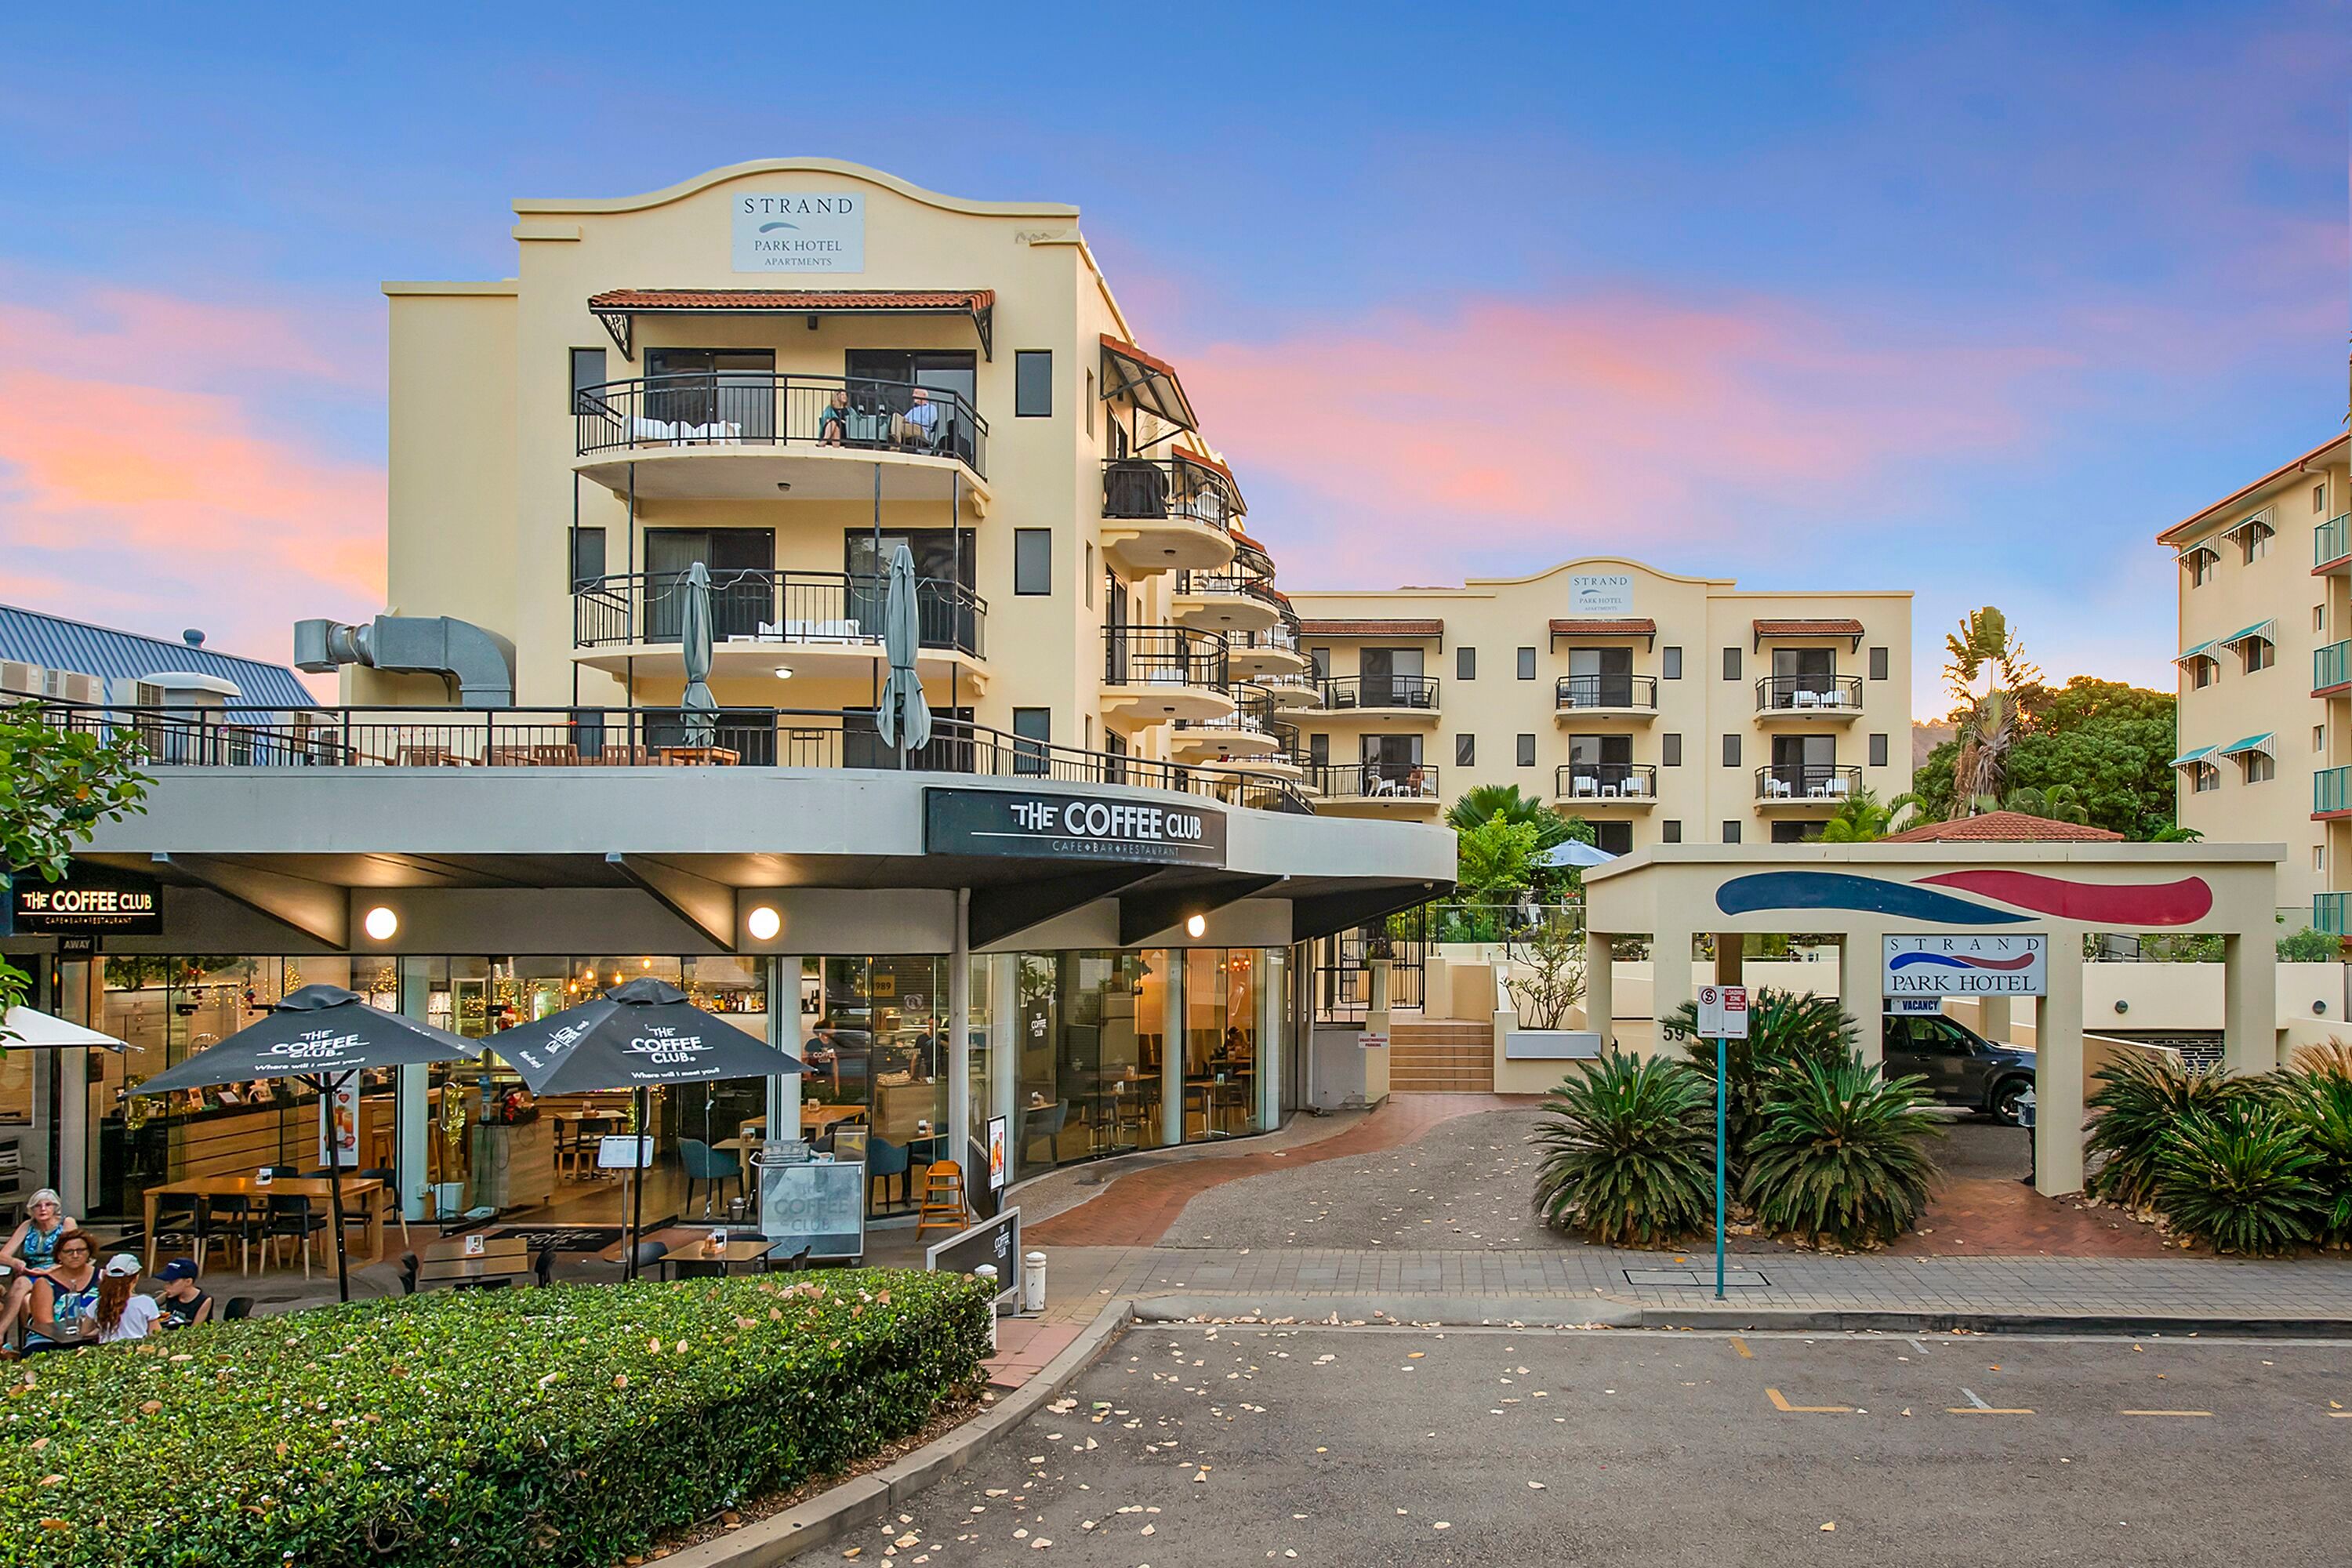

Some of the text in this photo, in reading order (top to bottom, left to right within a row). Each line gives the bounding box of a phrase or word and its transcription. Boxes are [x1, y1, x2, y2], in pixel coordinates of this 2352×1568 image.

[744, 198, 852, 214] STRAND
[754, 240, 842, 251] PARK HOTEL
[1573, 577, 1628, 586] STRAND
[1011, 801, 1203, 840] THE COFFEE CLUB
[1052, 840, 1179, 857] CAFE BAR RESTAURANT
[22, 890, 152, 911] THE COFFEE CLUB
[64, 940, 91, 949] AWAY
[1890, 938, 2039, 950] STRAND
[1892, 975, 2036, 991] PARK HOTEL
[1902, 1000, 1939, 1011] VACANCY
[299, 1029, 334, 1040] THE
[648, 1027, 676, 1038] THE
[1663, 1025, 1685, 1041] 59
[270, 1034, 358, 1054] COFFEE
[631, 1036, 702, 1051] COFFEE
[631, 1070, 659, 1079] Where
[774, 1197, 848, 1216] COFFEE
[791, 1218, 831, 1232] CLUB
